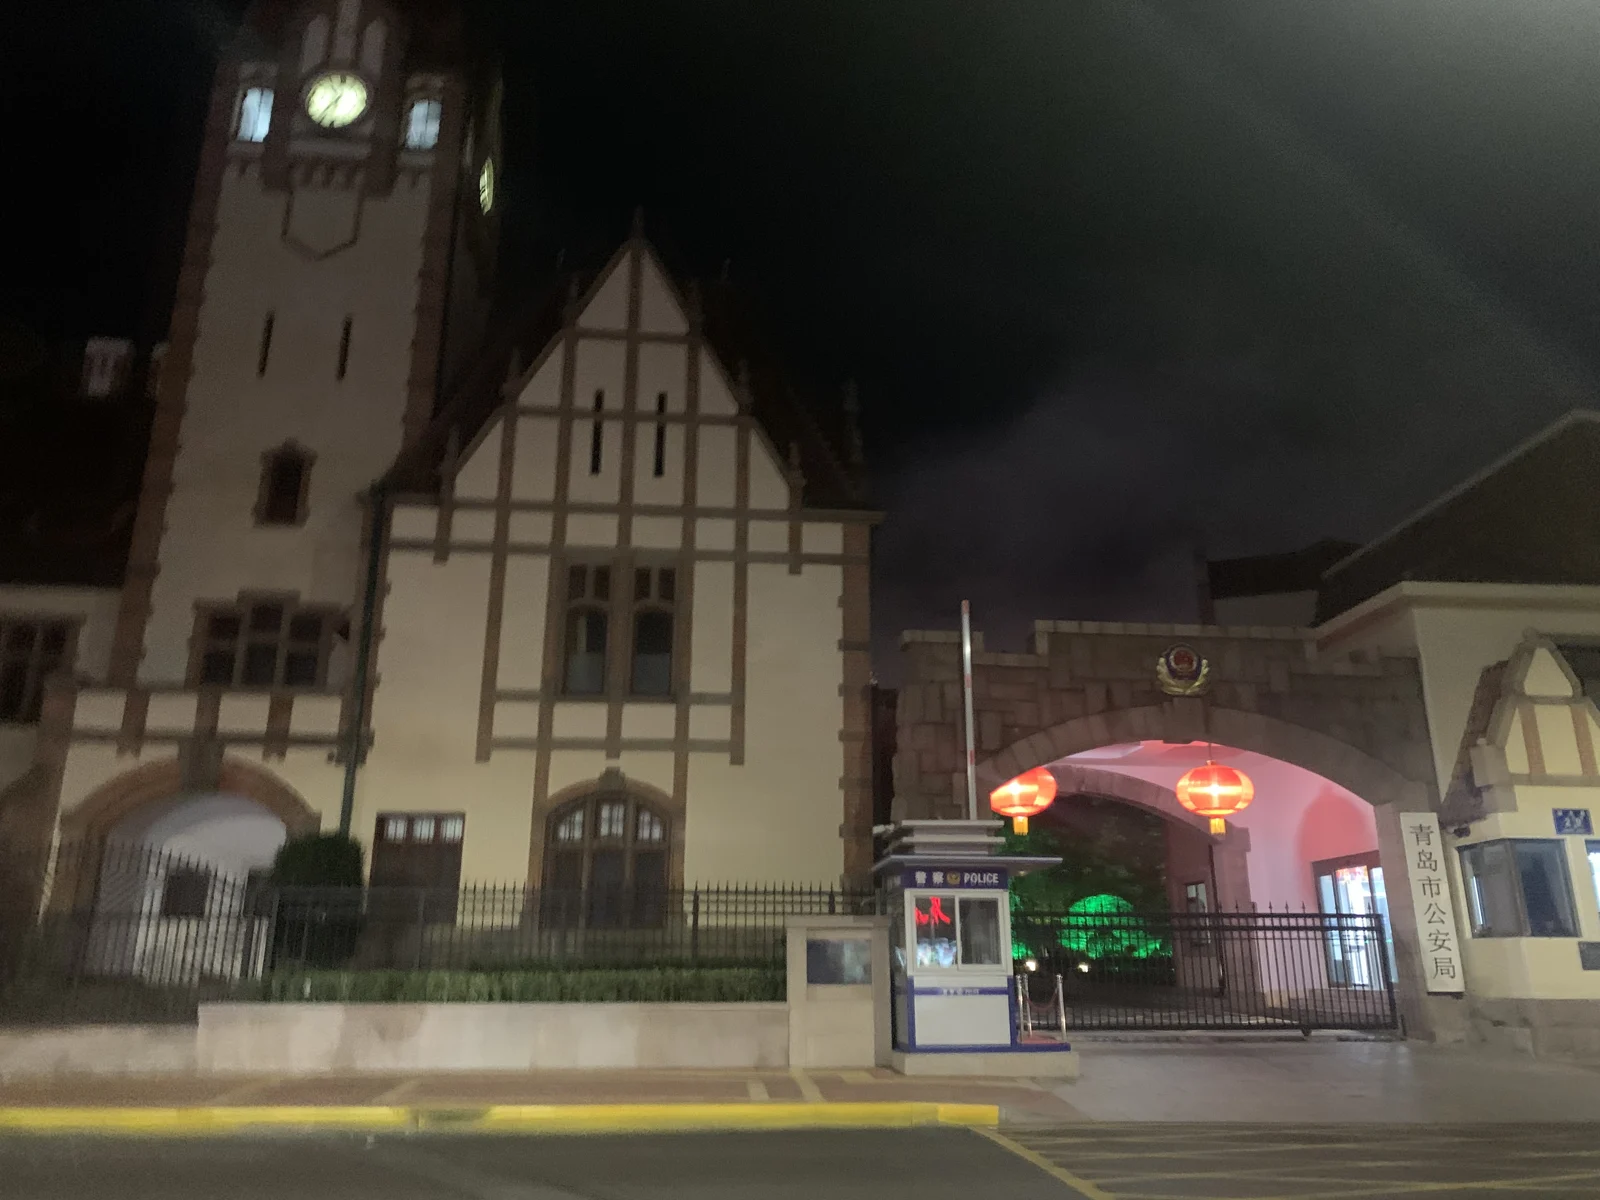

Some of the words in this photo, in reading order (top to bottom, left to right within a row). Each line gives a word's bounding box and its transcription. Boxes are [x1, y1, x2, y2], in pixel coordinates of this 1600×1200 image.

[964, 872, 999, 884] POLICE
[1410, 823, 1456, 979] 青岛市公安局
